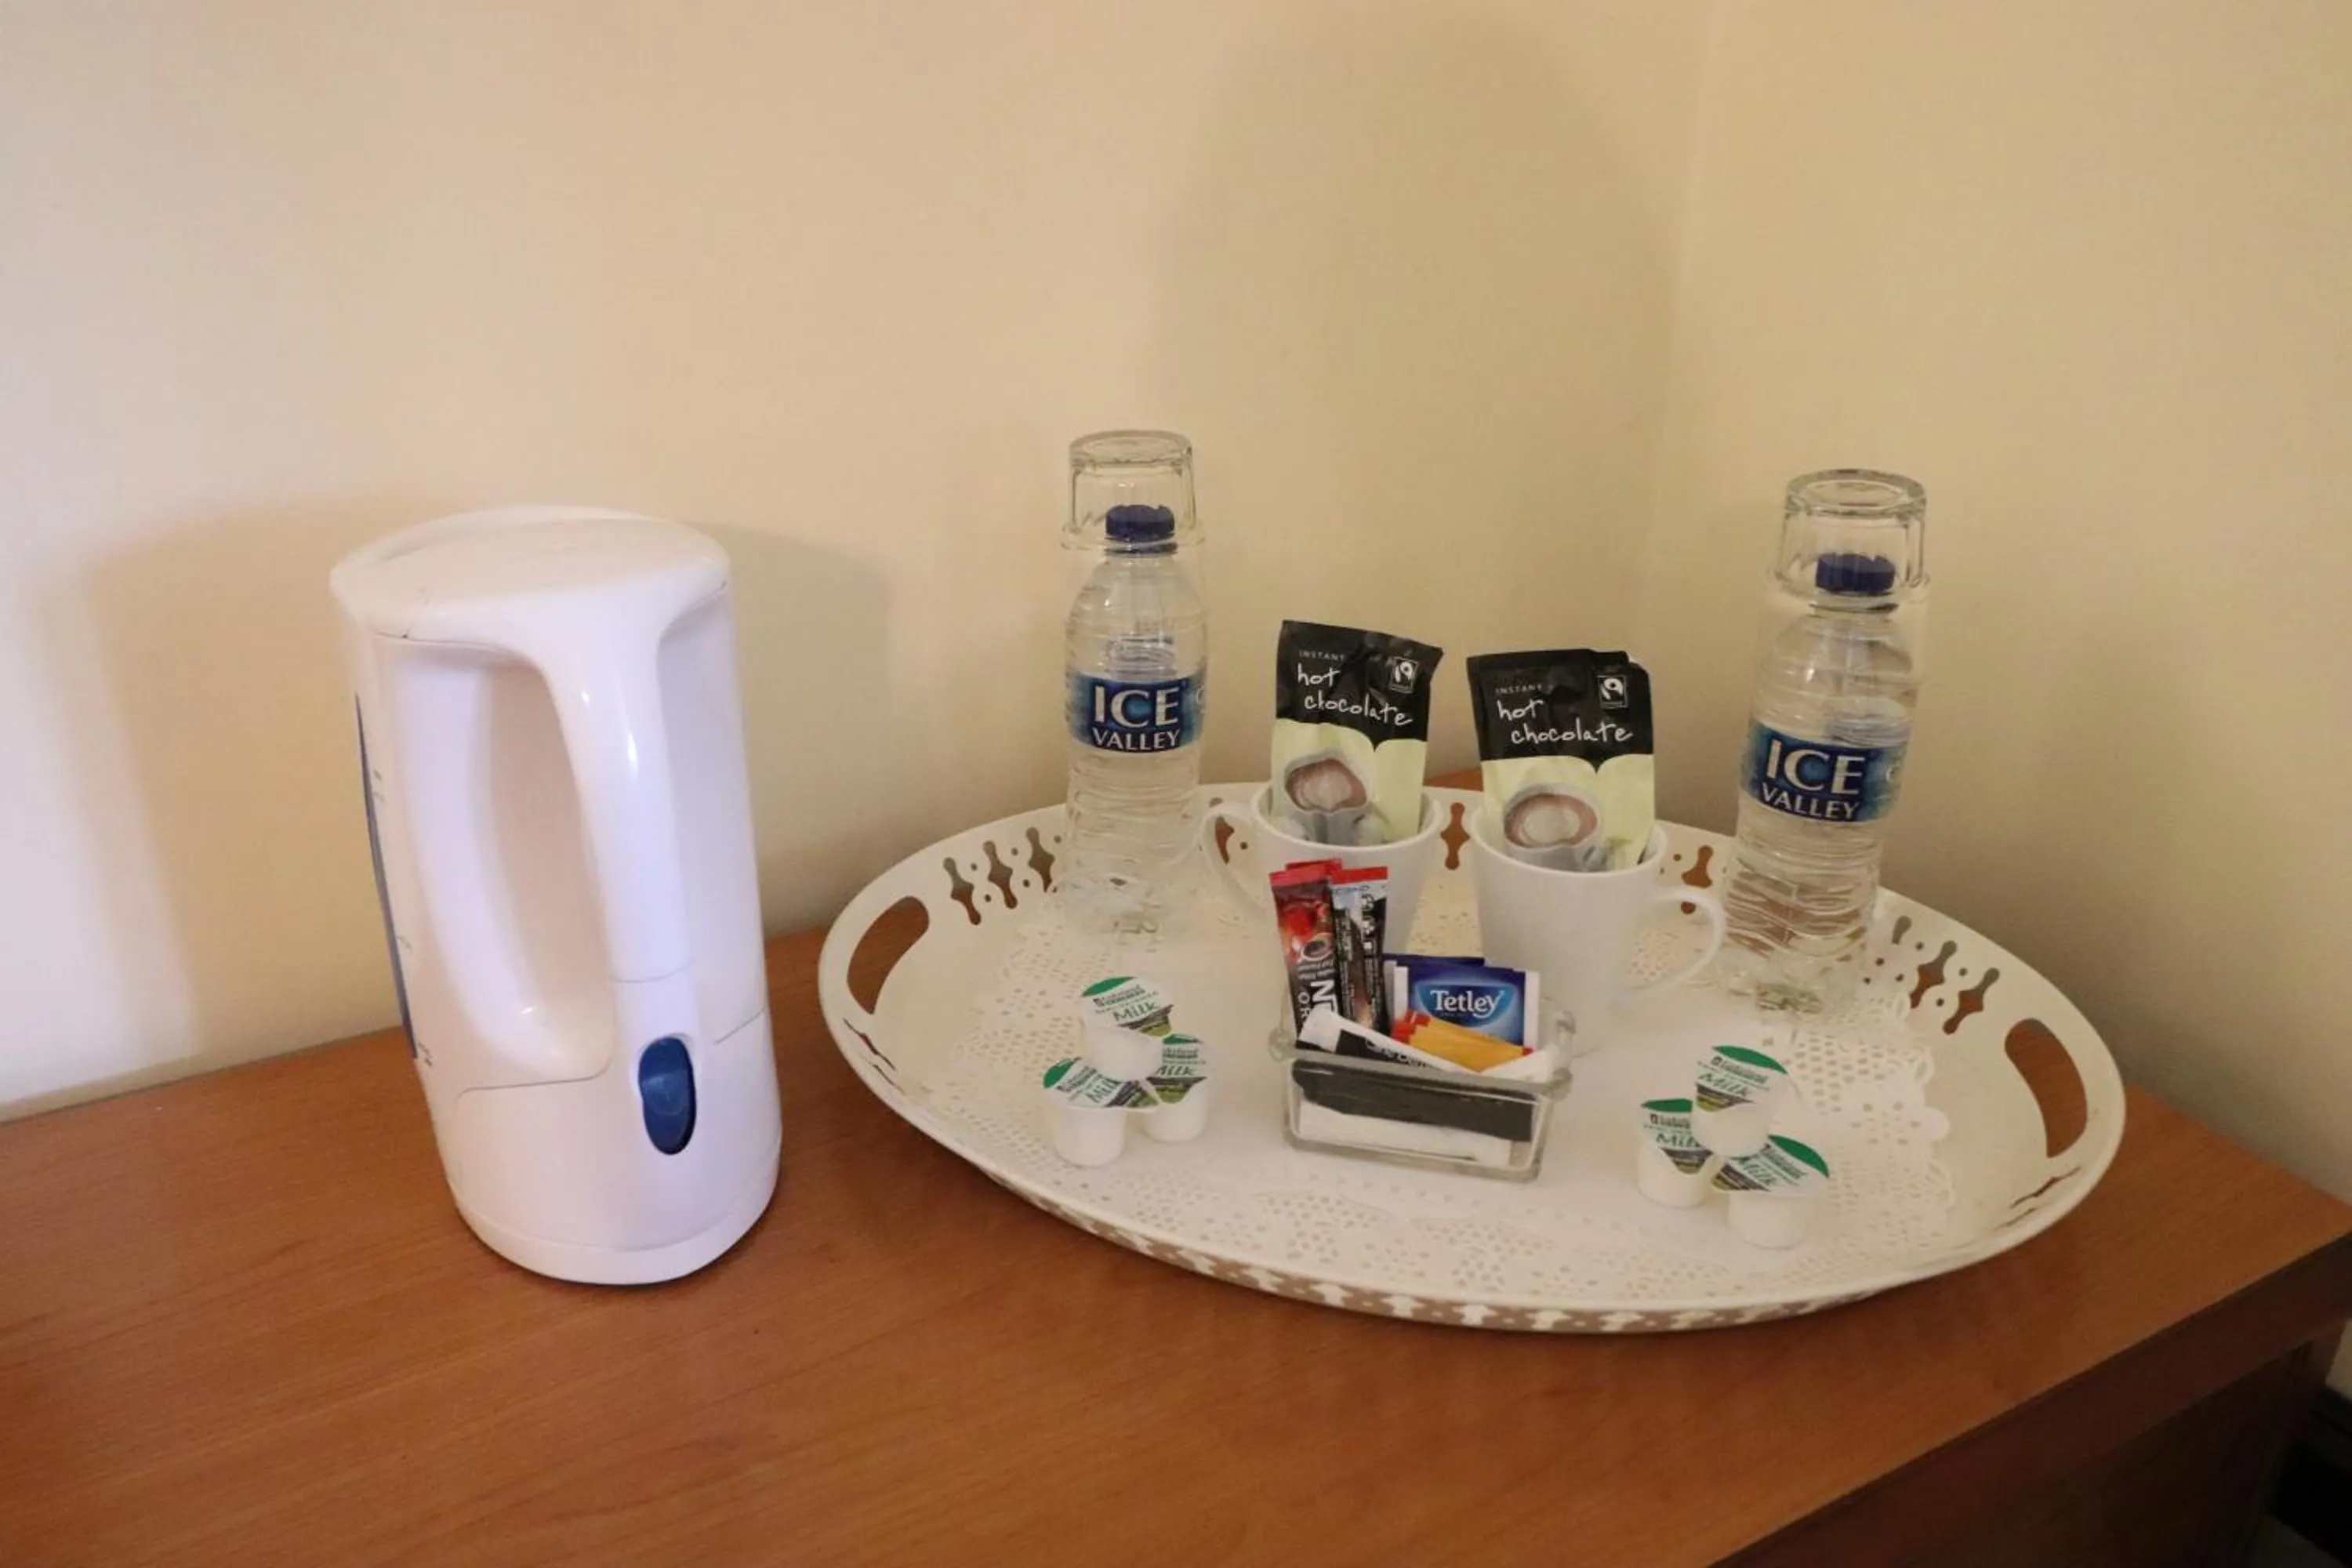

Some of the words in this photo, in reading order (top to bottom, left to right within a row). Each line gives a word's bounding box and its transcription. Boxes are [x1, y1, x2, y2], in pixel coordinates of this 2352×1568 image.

[1298, 662, 1341, 687] hot
[1094, 685, 1180, 728] ICE
[1304, 689, 1414, 727] chocolate
[1496, 699, 1544, 721] hot
[1091, 728, 1181, 750] VALLEY
[1510, 717, 1634, 745] chocolate
[1766, 739, 1866, 795] ICE
[1762, 781, 1860, 819] VALLEY
[1112, 1000, 1160, 1022] Milk
[1429, 988, 1505, 1019] Tetley
